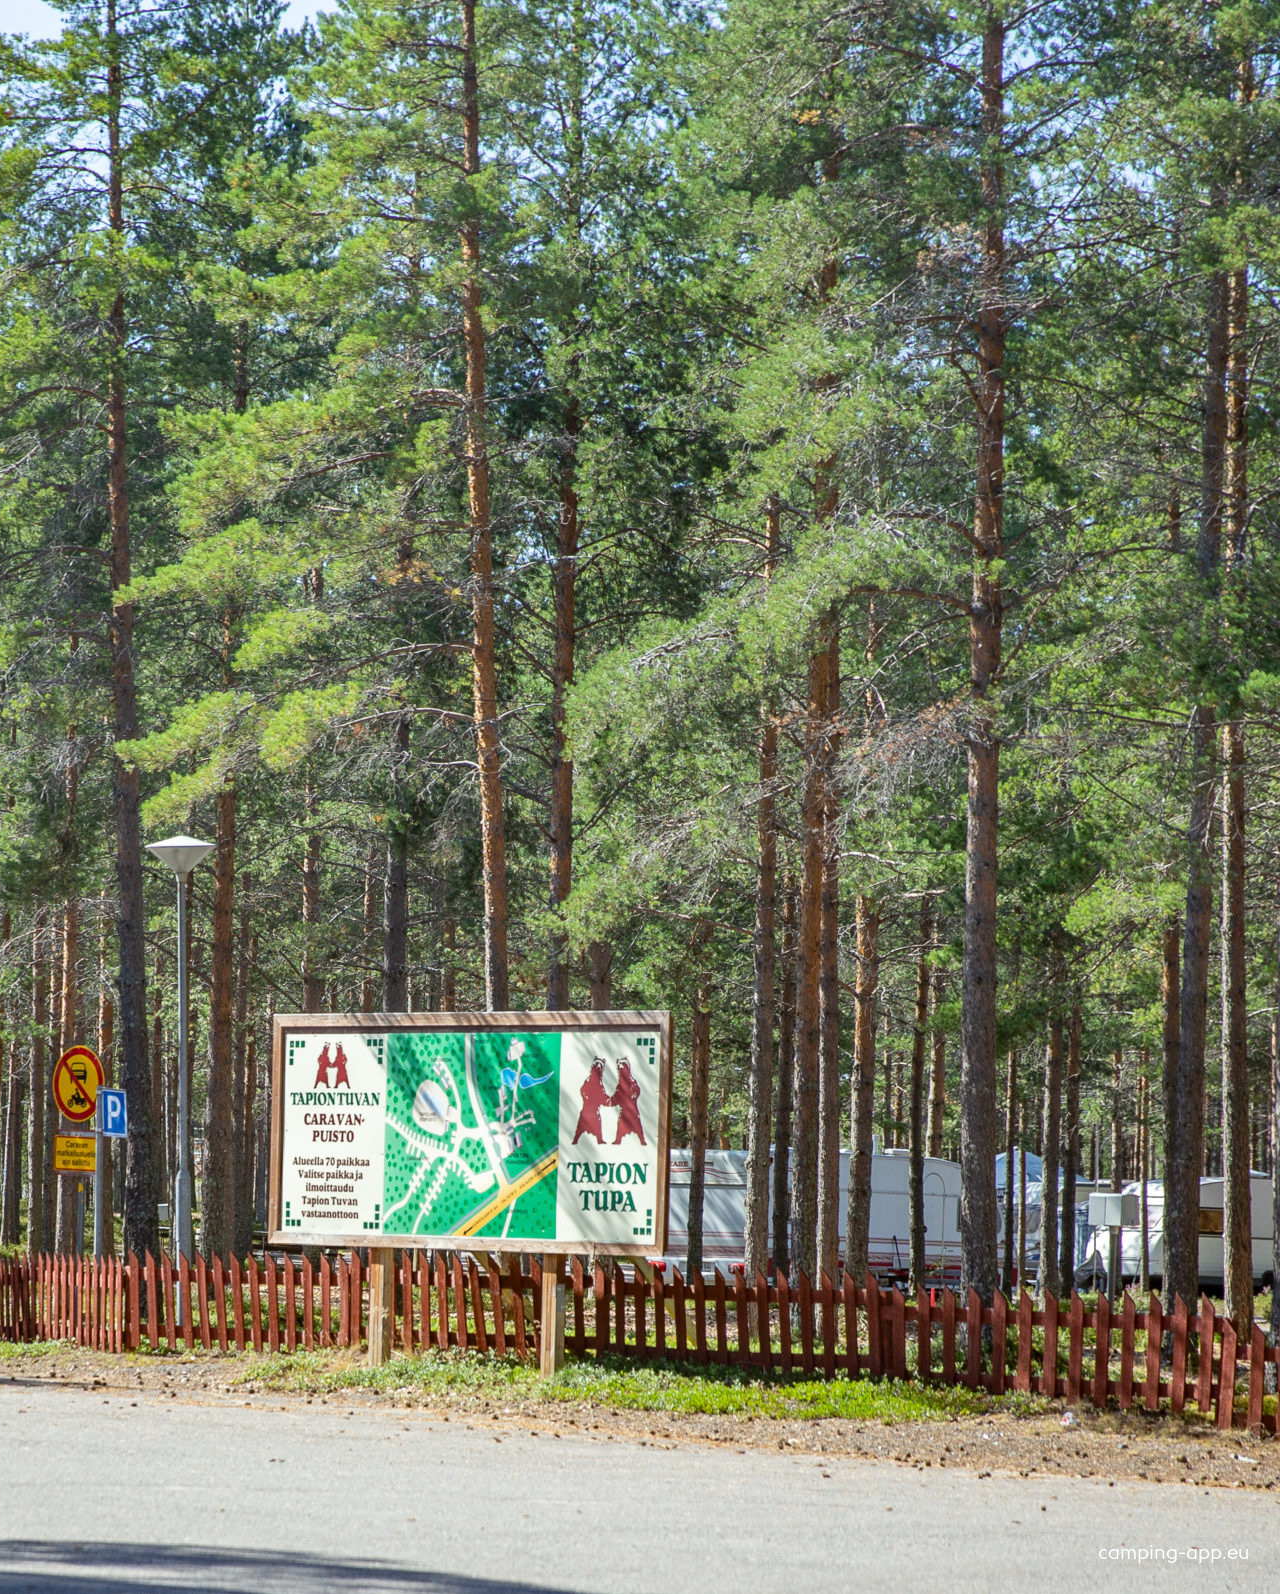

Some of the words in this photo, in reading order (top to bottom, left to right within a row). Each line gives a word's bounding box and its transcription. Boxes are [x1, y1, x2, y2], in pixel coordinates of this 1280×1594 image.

[107, 1095, 121, 1129] P
[312, 1130, 354, 1142] PUISTO
[66, 1140, 88, 1149] Caravan
[293, 1157, 324, 1166] Alueella
[325, 1157, 335, 1166] 70
[336, 1157, 370, 1168] paikkaa
[298, 1169, 325, 1179] Valitse
[325, 1170, 354, 1181] paikka
[355, 1170, 363, 1181] ja
[567, 1162, 648, 1185] TAPION
[305, 1182, 354, 1192] ilmoittaudu
[302, 1196, 330, 1207] Tapion
[331, 1197, 358, 1206] Tuvan
[579, 1190, 637, 1212] TUPA
[301, 1210, 359, 1219] vastaanottoon
